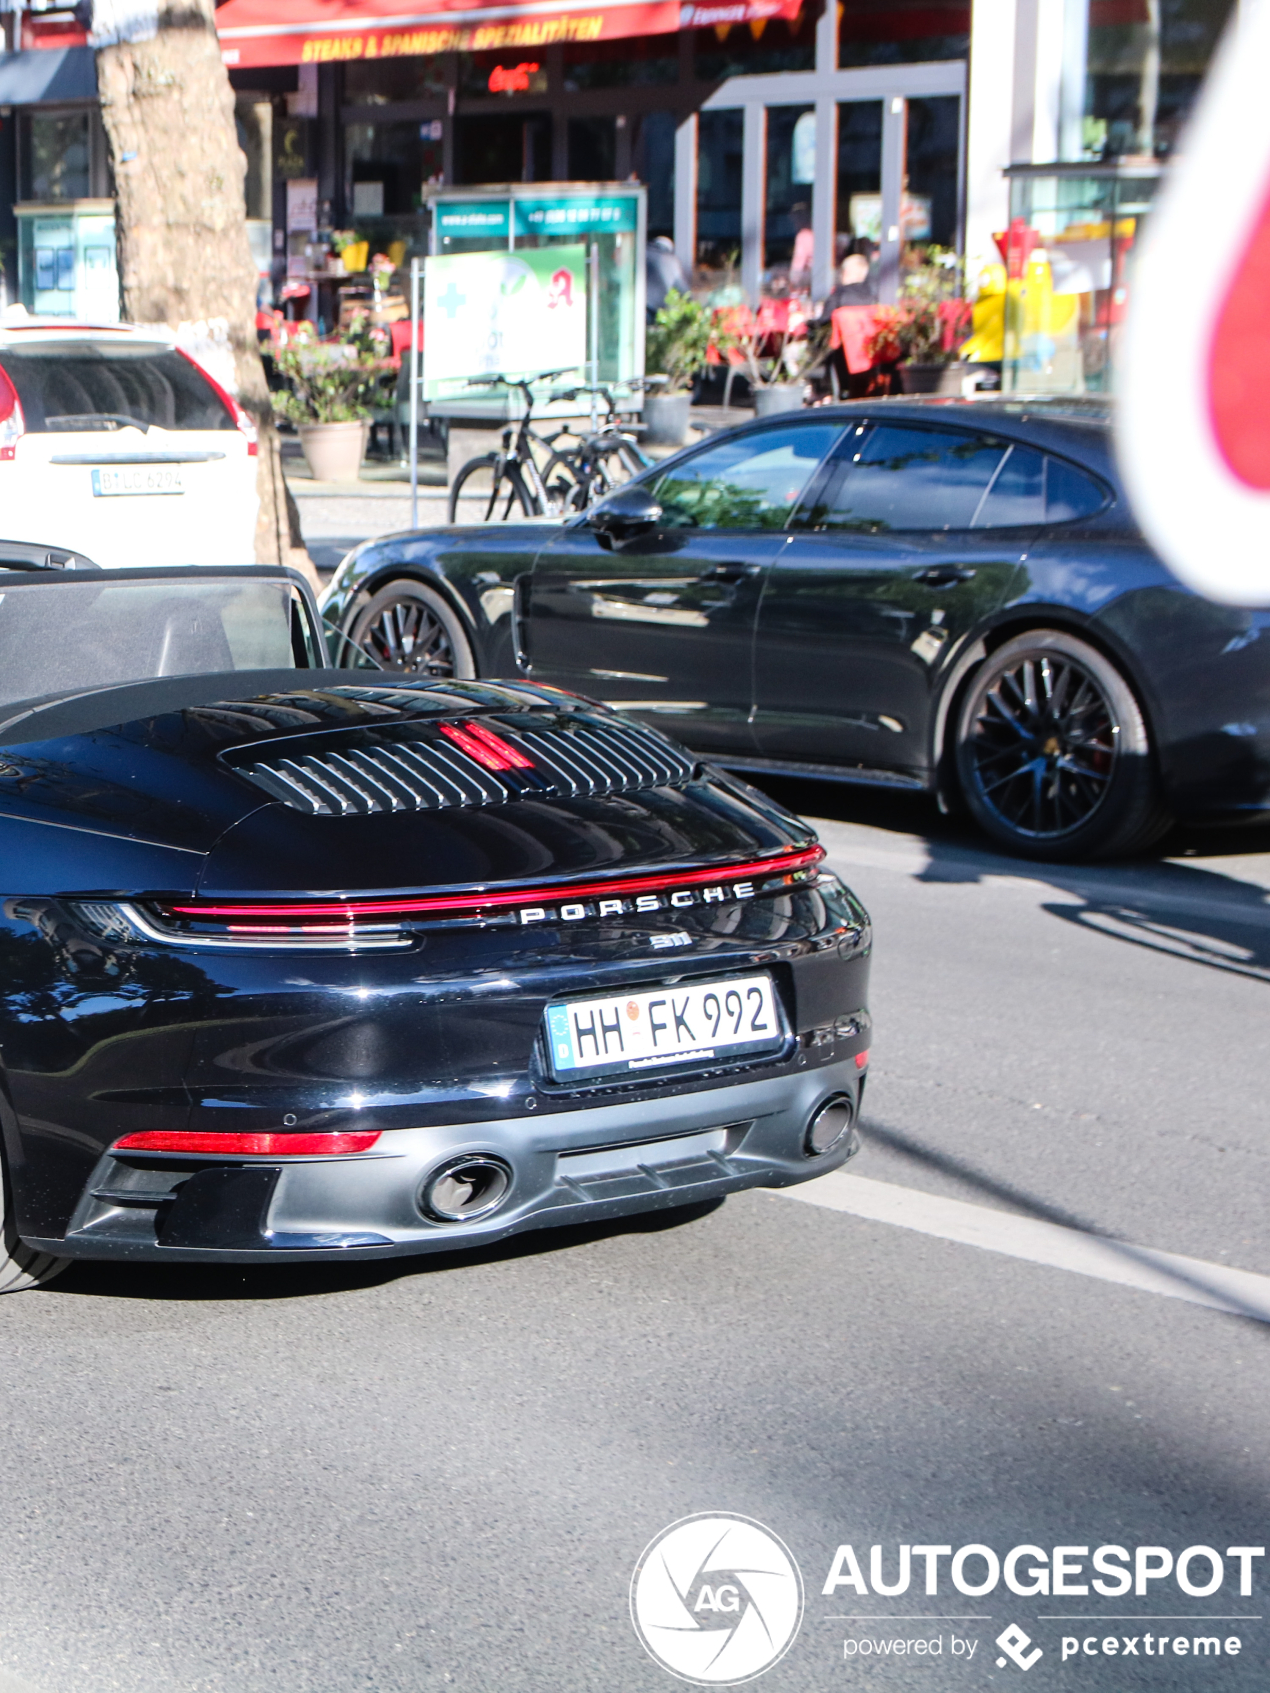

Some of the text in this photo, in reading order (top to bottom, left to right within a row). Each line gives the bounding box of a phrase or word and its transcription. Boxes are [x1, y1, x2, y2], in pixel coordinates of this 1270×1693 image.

[302, 15, 604, 62] STEAKS & SPANISCHE SPEZIALITÄTEN
[520, 882, 755, 924] PORSCHE
[649, 931, 693, 949] 911
[574, 987, 768, 1058] HH FK 992
[558, 1043, 569, 1059] D
